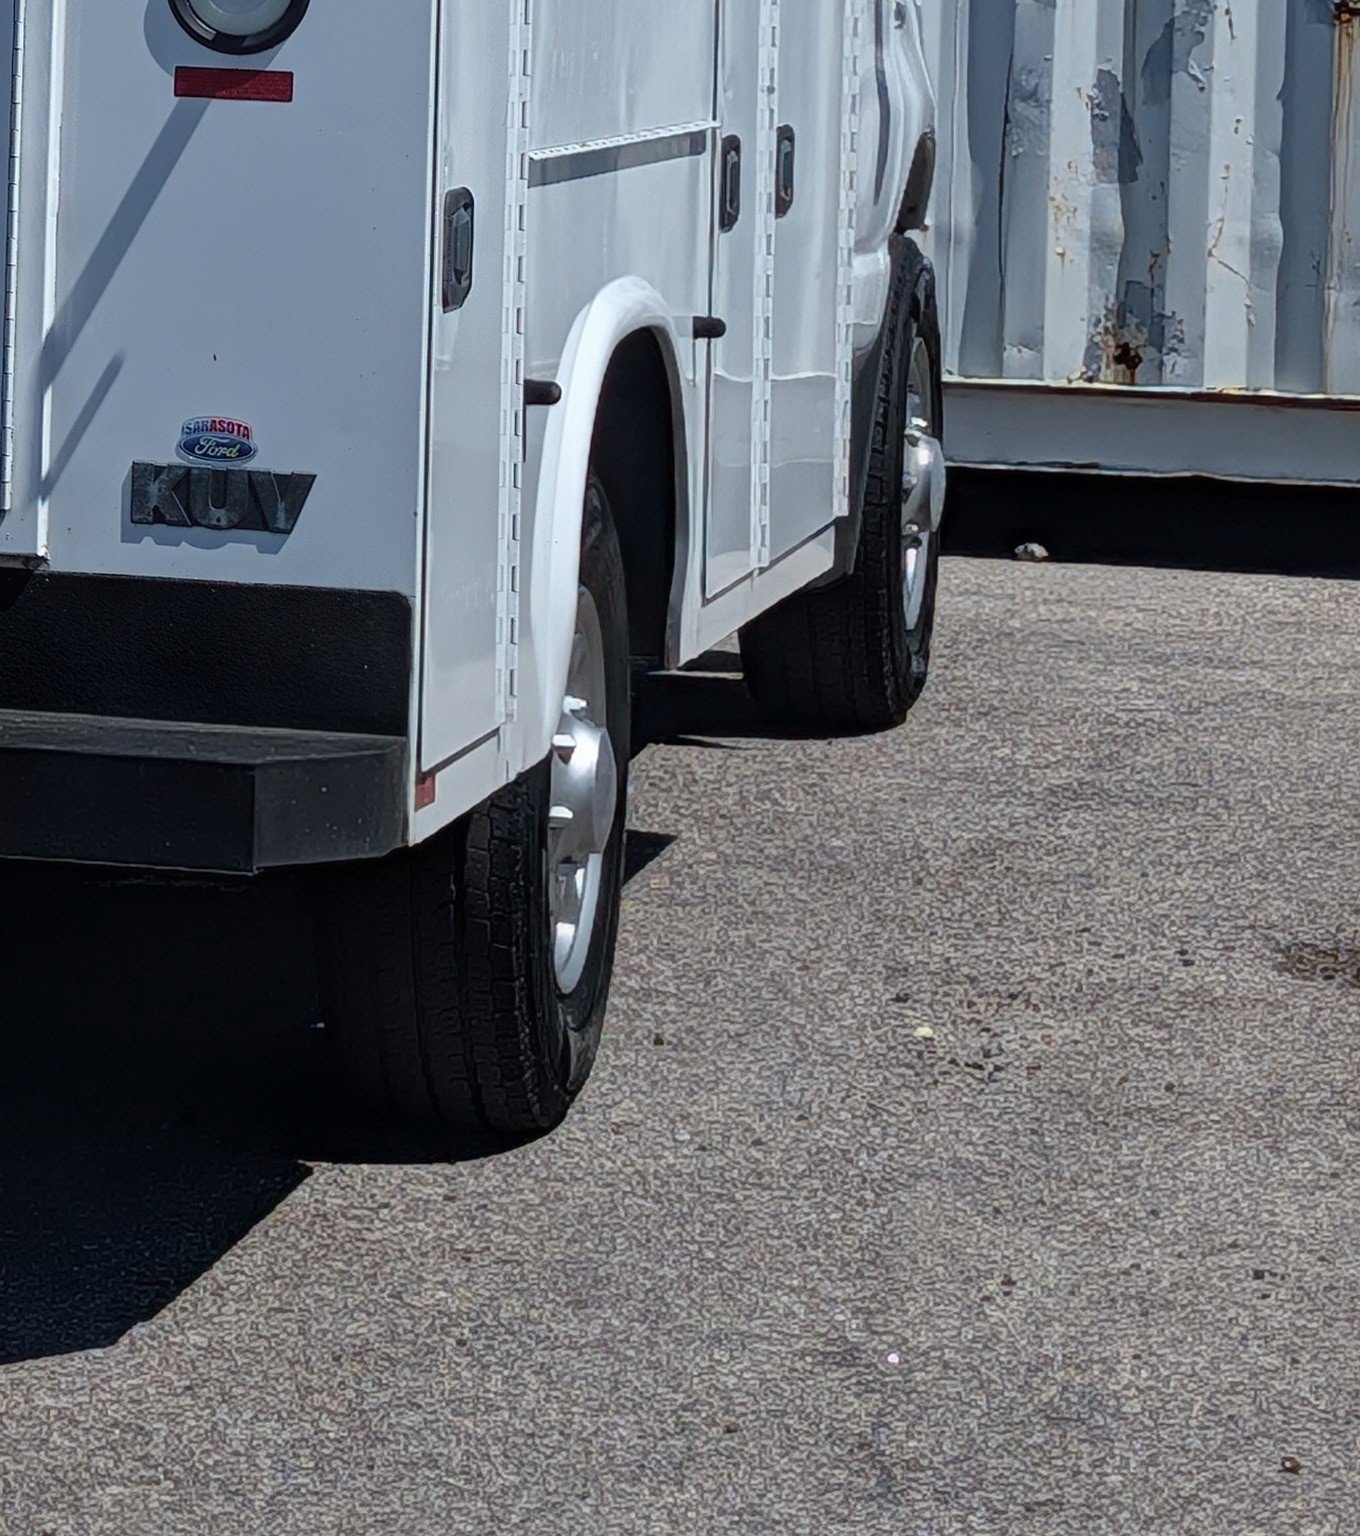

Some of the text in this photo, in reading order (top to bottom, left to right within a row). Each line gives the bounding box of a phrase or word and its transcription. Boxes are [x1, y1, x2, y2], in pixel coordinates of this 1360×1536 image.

[184, 419, 251, 441] SARASOTA
[194, 436, 241, 458] Ford
[131, 461, 317, 534] KUV
